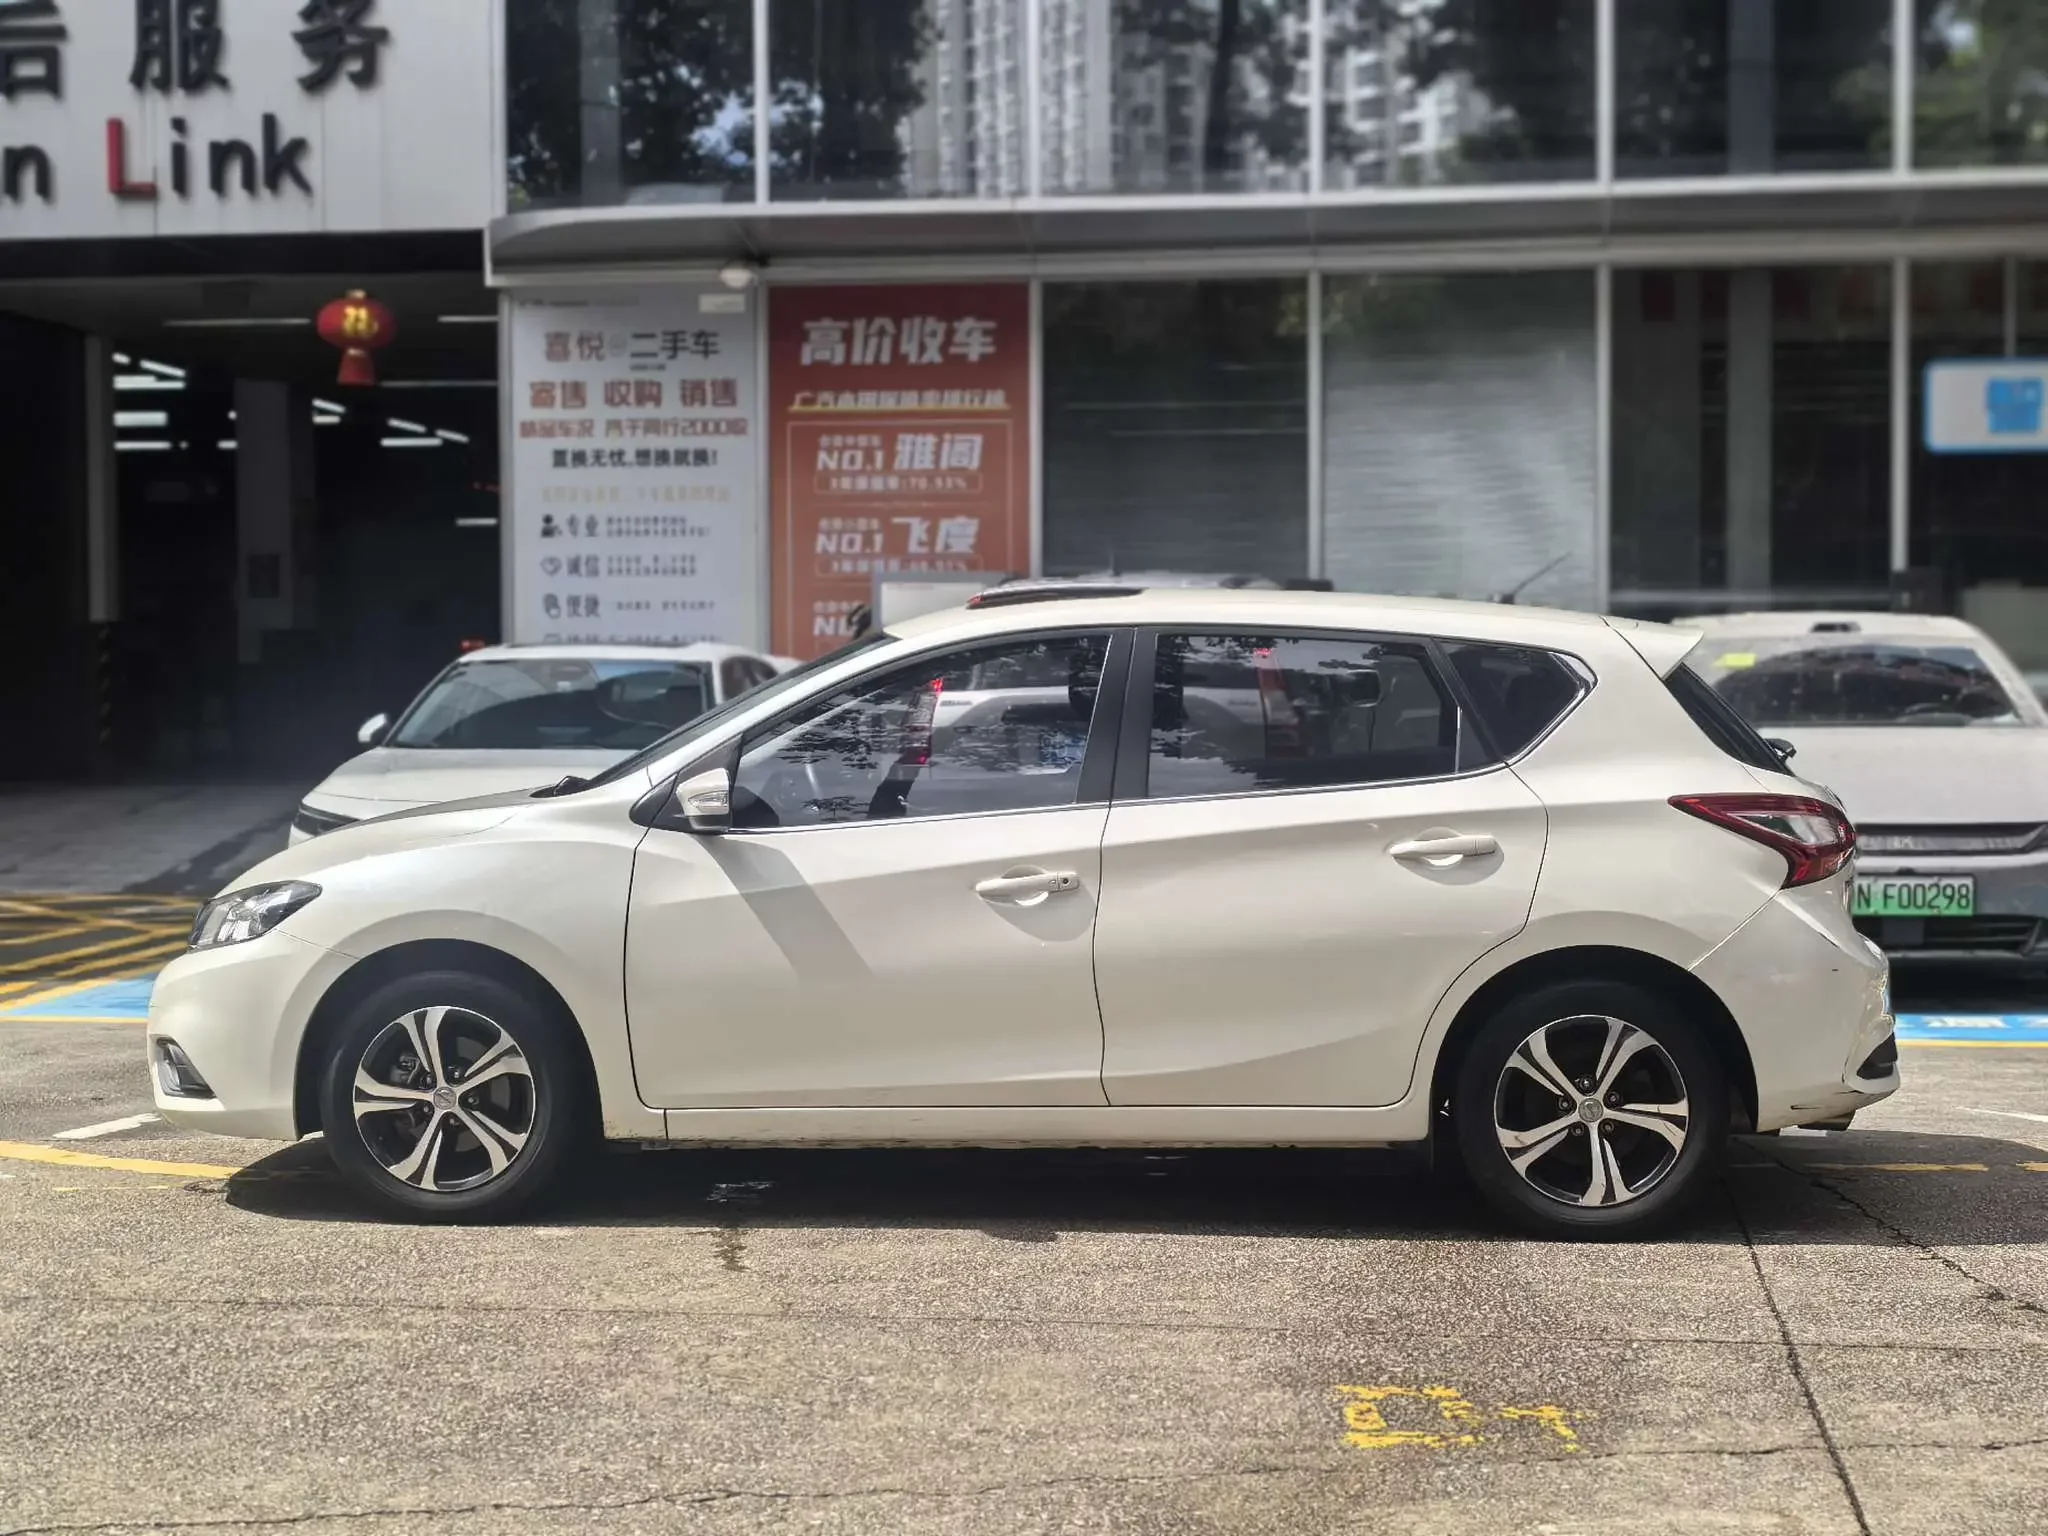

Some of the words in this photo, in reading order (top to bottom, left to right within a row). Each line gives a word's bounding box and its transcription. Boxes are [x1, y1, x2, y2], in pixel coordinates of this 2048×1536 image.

[107, 112, 313, 201] Link
[630, 330, 721, 360] 二手车
[801, 316, 998, 366] 高价收车
[816, 450, 885, 471] NO.1
[893, 433, 984, 471] 雅阁
[815, 533, 885, 554] NO.1
[892, 515, 980, 554] 飞度
[1883, 883, 1971, 910] F00298
